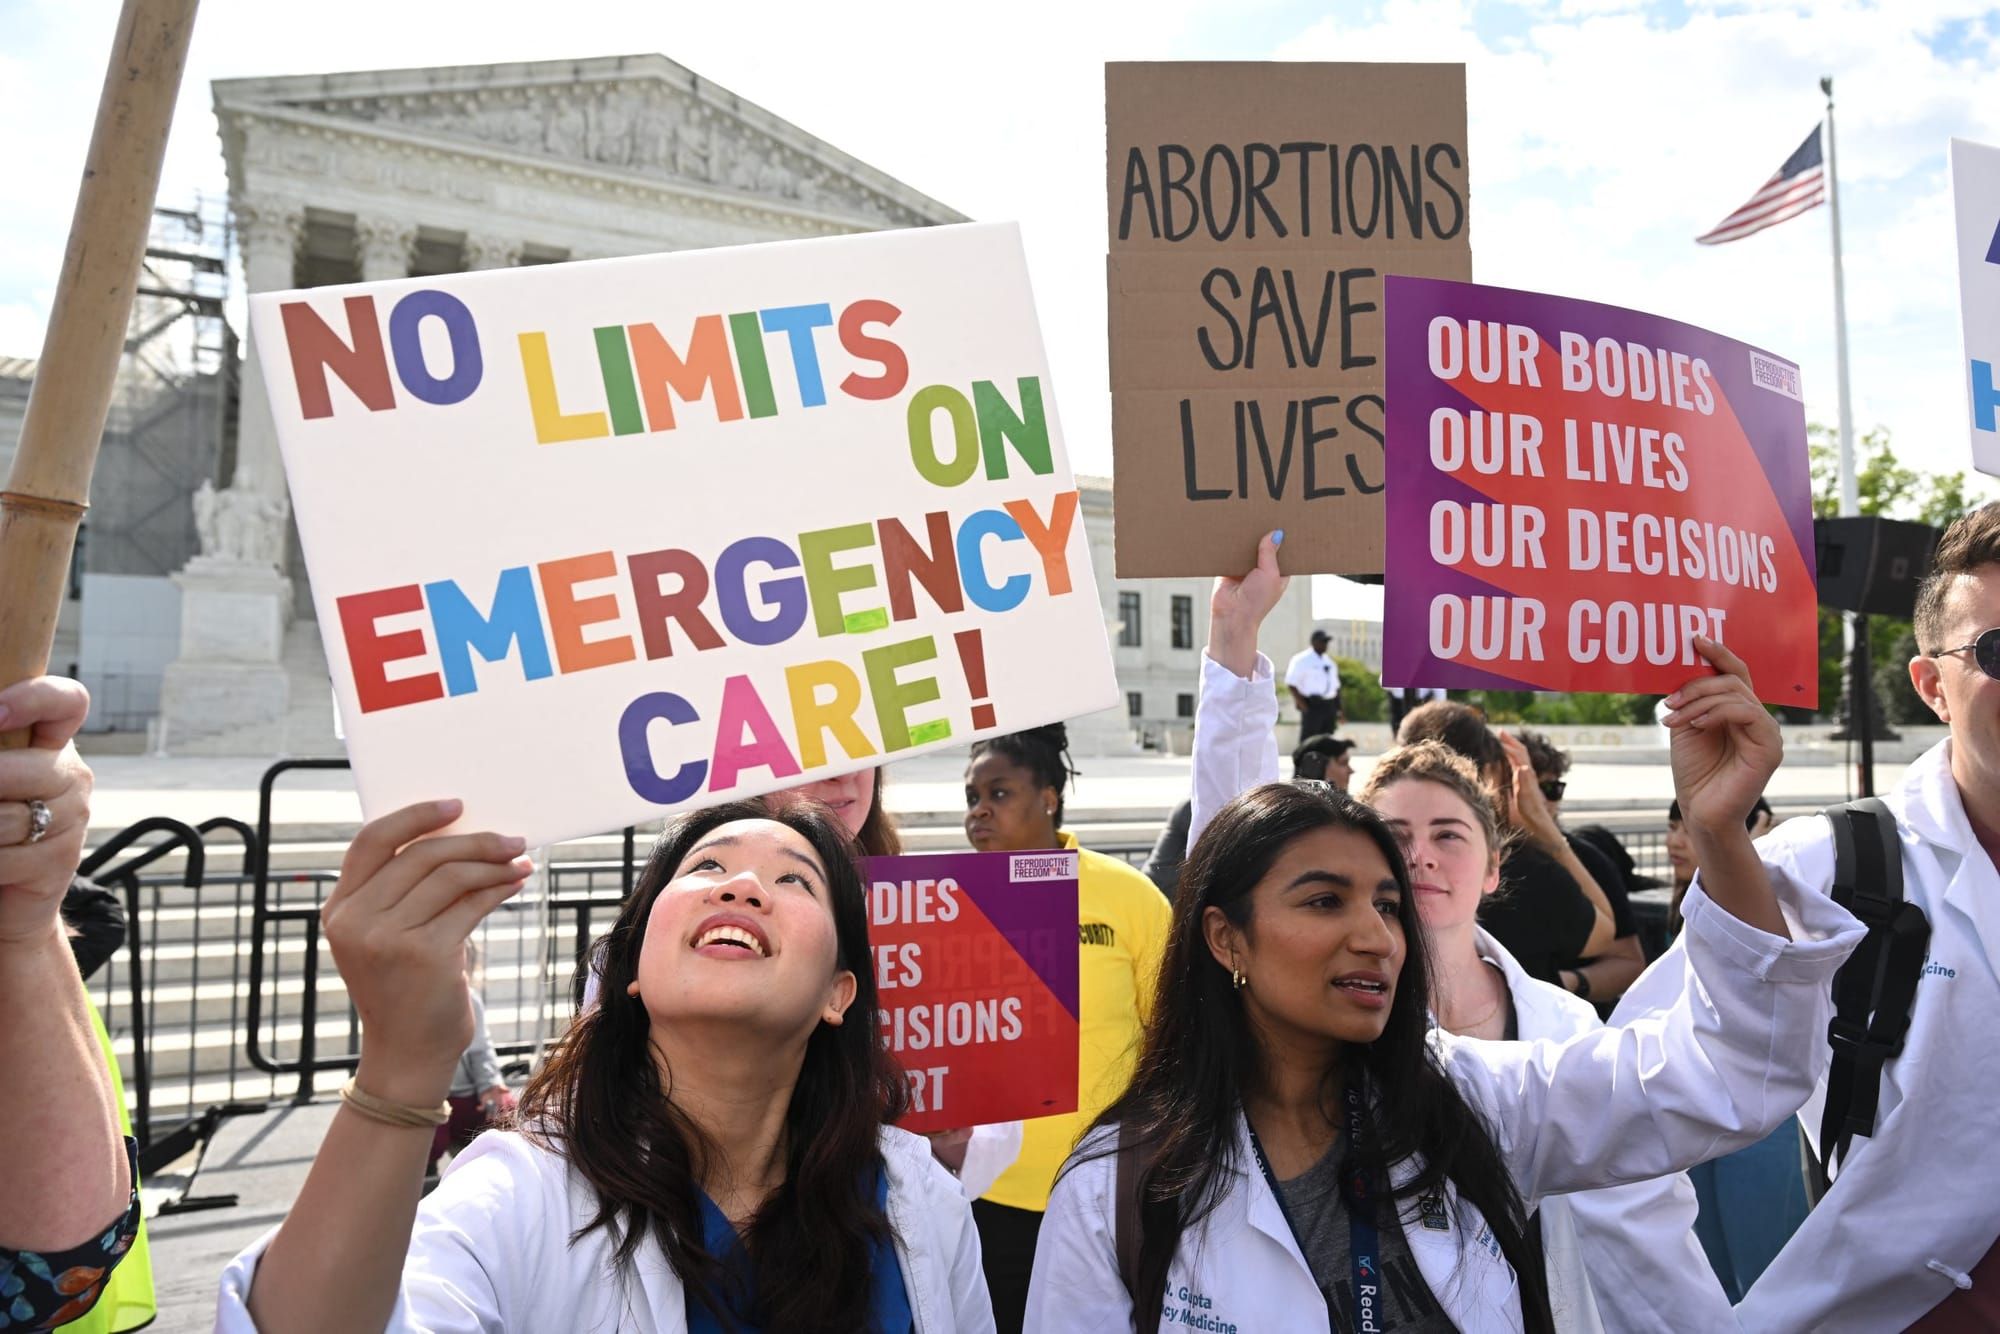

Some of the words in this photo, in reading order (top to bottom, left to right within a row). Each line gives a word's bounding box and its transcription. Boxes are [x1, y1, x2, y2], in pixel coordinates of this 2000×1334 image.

[1118, 142, 1463, 242] ABORTIONS
[1197, 267, 1376, 371] SAVE
[1428, 316, 1541, 388] OUR
[1560, 331, 1715, 416] BODIES
[280, 289, 483, 419] NO
[518, 299, 909, 444] LIMITS
[907, 376, 1054, 488] ON
[1180, 395, 1384, 502] LIVES
[1429, 407, 1545, 478] OUR
[1564, 419, 1689, 491] LIVES
[1429, 500, 1546, 568] OUR
[1568, 508, 1777, 594] DECISIONS
[337, 491, 1080, 714] EMERGENCY
[1429, 594, 1546, 661] OUR
[618, 629, 997, 805] CARE!
[865, 878, 959, 926] DIES
[1014, 857, 1069, 869] REPRODUCTIVE
[1015, 868, 1050, 878] FREEDOM
[1056, 867, 1070, 876] ALL
[870, 943, 922, 989] ES
[1179, 1287, 1212, 1309] Gupta
[1179, 1308, 1237, 1334] Medicine
